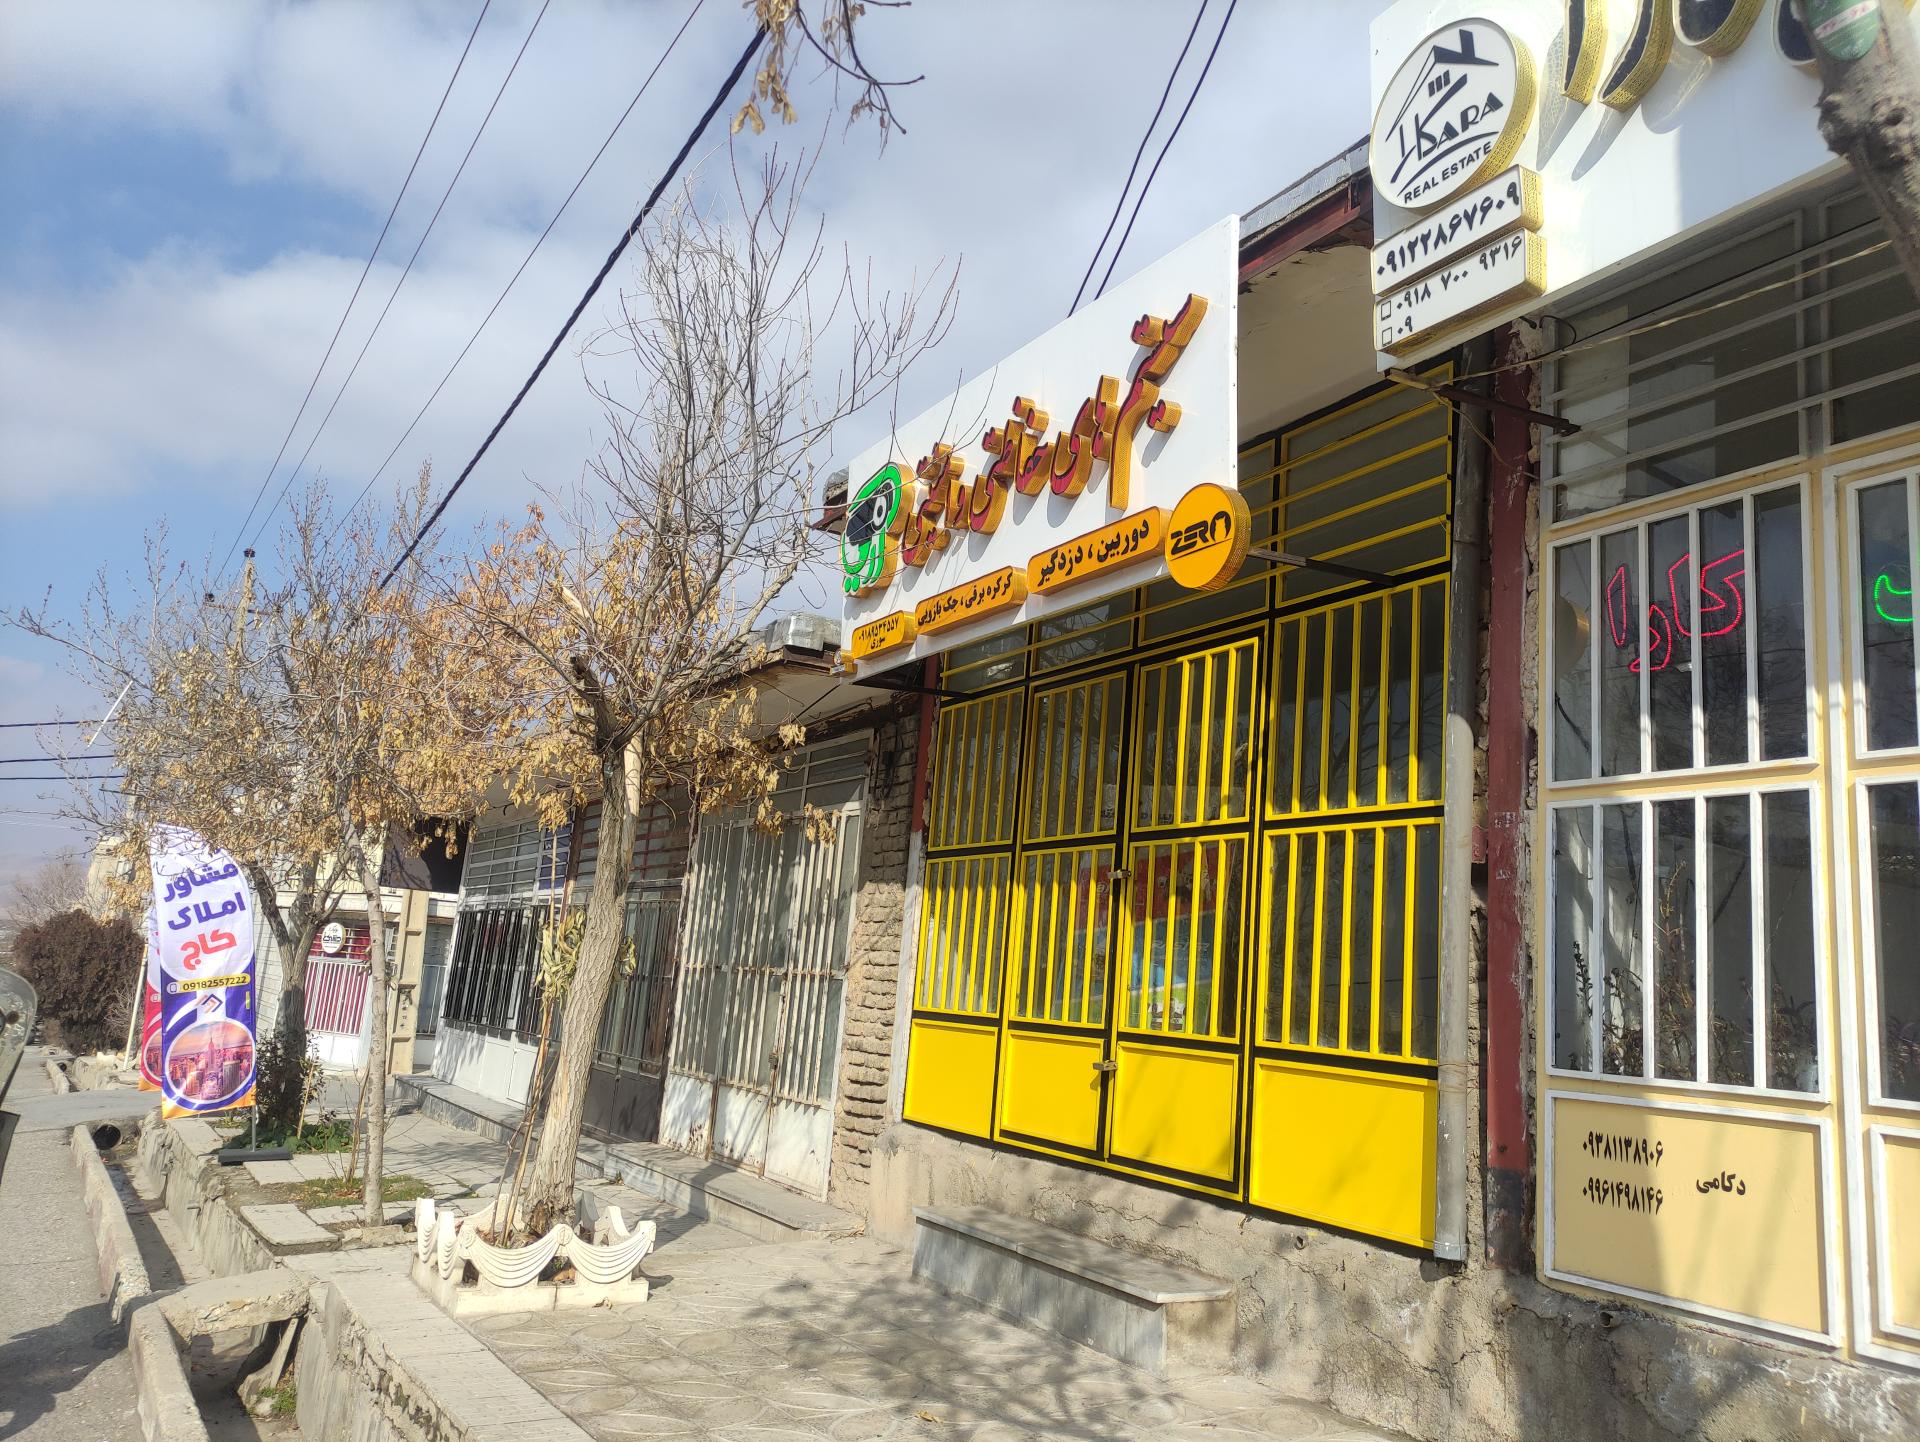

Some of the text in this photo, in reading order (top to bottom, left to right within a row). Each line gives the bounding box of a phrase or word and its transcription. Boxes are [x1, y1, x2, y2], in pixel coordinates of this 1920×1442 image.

[1413, 73, 1504, 161] KARA
[1403, 140, 1493, 204] REAL ESTATE
[1396, 235, 1522, 310] ۰۹۱۸ ۷۰۰ ۹۳۱۶
[1096, 518, 1150, 564] دوربین
[1037, 545, 1083, 588] دزدگیر
[163, 861, 239, 903] مشاور
[167, 891, 247, 931] املاک
[180, 928, 238, 971] کاج
[182, 975, 248, 992] 09182557222
[1582, 1130, 1664, 1168] ۰۹۳۸۱۱۳۸۹۰۶
[1582, 1176, 1664, 1216] ۰۹۹۶۱۴۹۸۱۴۶
